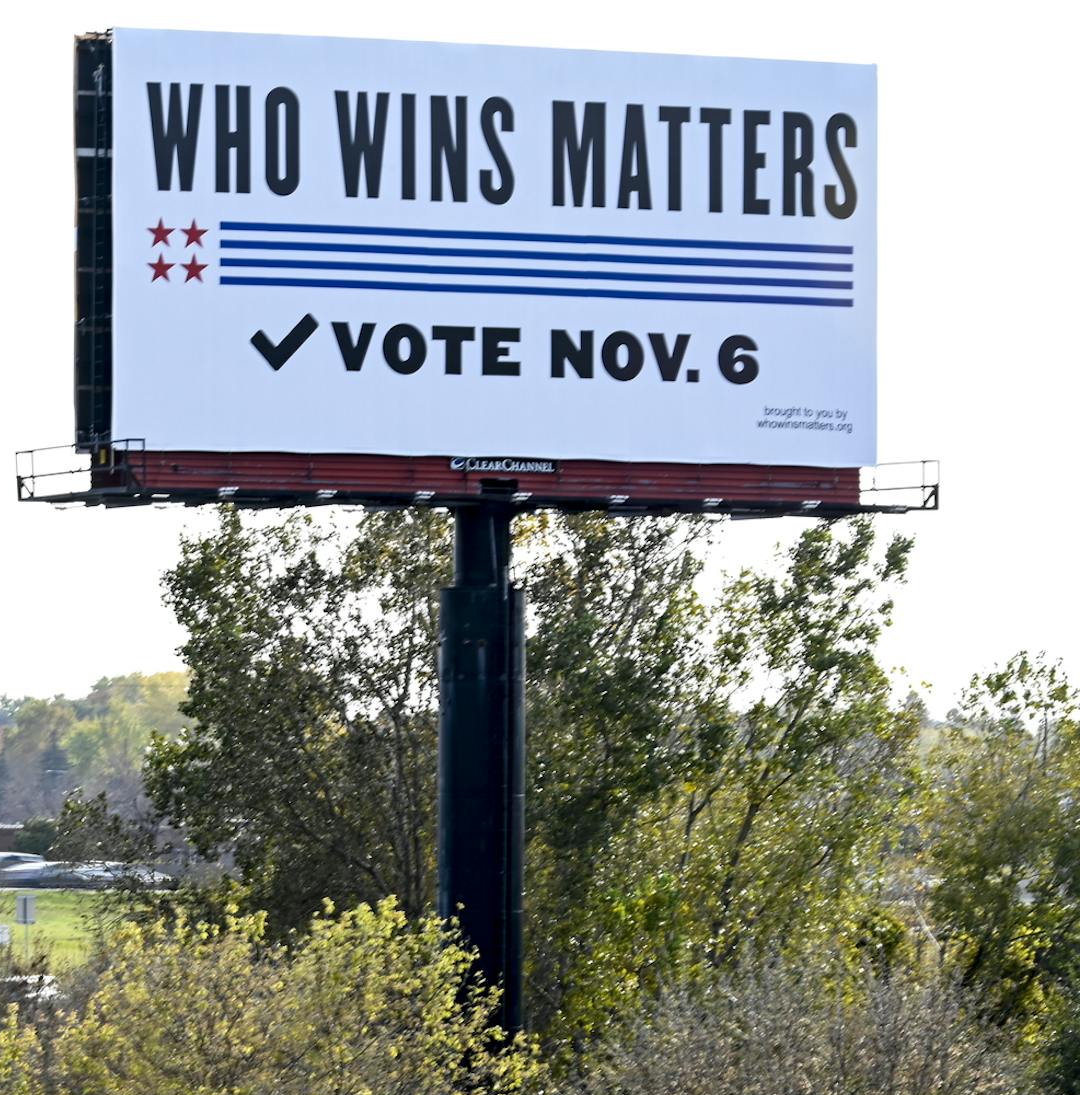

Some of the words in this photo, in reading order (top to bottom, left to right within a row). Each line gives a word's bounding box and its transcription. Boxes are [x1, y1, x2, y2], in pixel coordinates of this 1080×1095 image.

[147, 81, 300, 197] WHO
[335, 90, 515, 206] WINS
[553, 100, 858, 220] MATTERS
[331, 321, 521, 377] VOTE
[551, 329, 700, 383] NOV.
[717, 334, 759, 385] 6
[757, 418, 853, 434] whowinsmatters.org
[763, 406, 801, 418] brought
[804, 407, 813, 417] to
[816, 409, 833, 420] you
[836, 408, 848, 421] by
